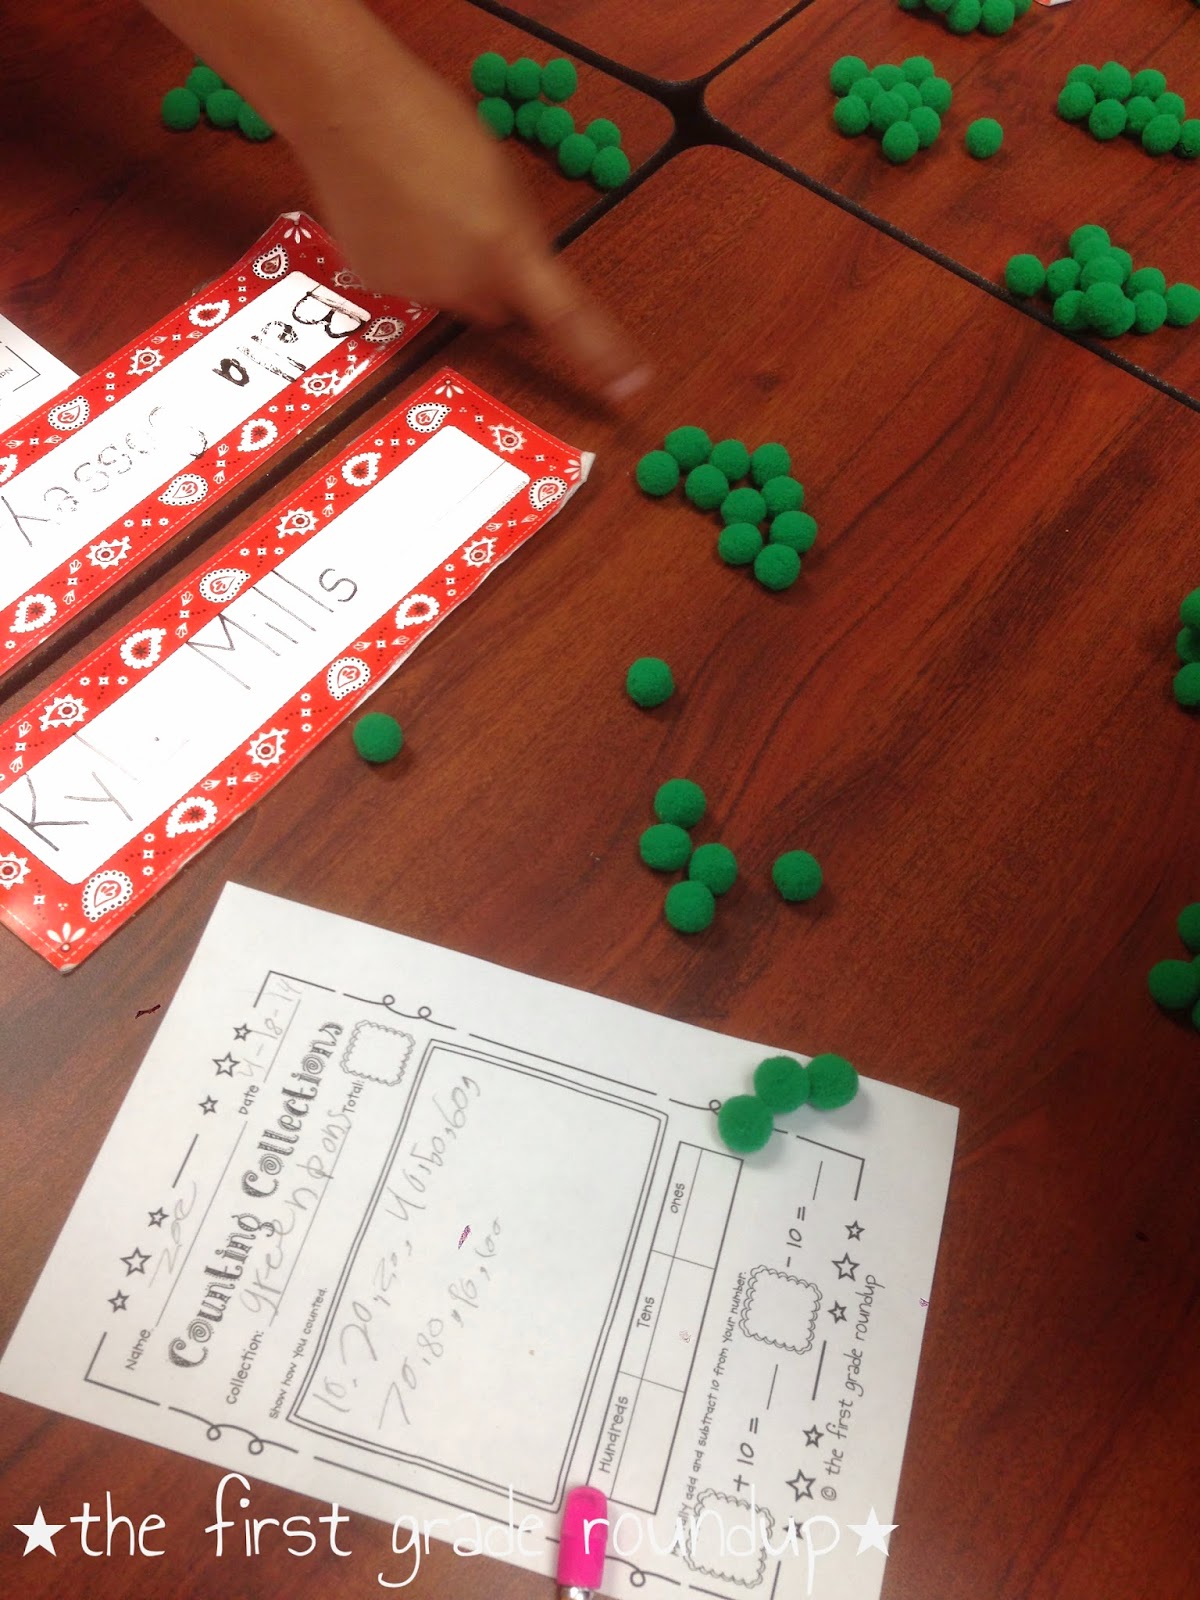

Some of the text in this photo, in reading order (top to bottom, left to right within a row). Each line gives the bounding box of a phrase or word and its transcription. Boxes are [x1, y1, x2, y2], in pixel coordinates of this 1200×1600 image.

[212, 286, 368, 387] Bella
[186, 567, 358, 690] Mills
[238, 1084, 261, 1116] Date
[343, 1079, 366, 1114] Total:
[168, 1022, 344, 1368] Counting Collections
[785, 1227, 803, 1249] 10
[636, 1296, 656, 1329] Tens
[729, 1271, 747, 1316] number.
[854, 1273, 886, 1342] roundup
[280, 1362, 297, 1388] how
[303, 1287, 328, 1336] counted.
[712, 1346, 730, 1377] from
[843, 1347, 865, 1398] grade
[709, 1378, 721, 1392] 10
[600, 1396, 629, 1474] Hundreds
[697, 1392, 718, 1447] subtract
[822, 1397, 854, 1441] first
[692, 1449, 706, 1474] and
[735, 1441, 755, 1467] 10
[822, 1447, 845, 1476] the
[685, 1475, 699, 1501] add
